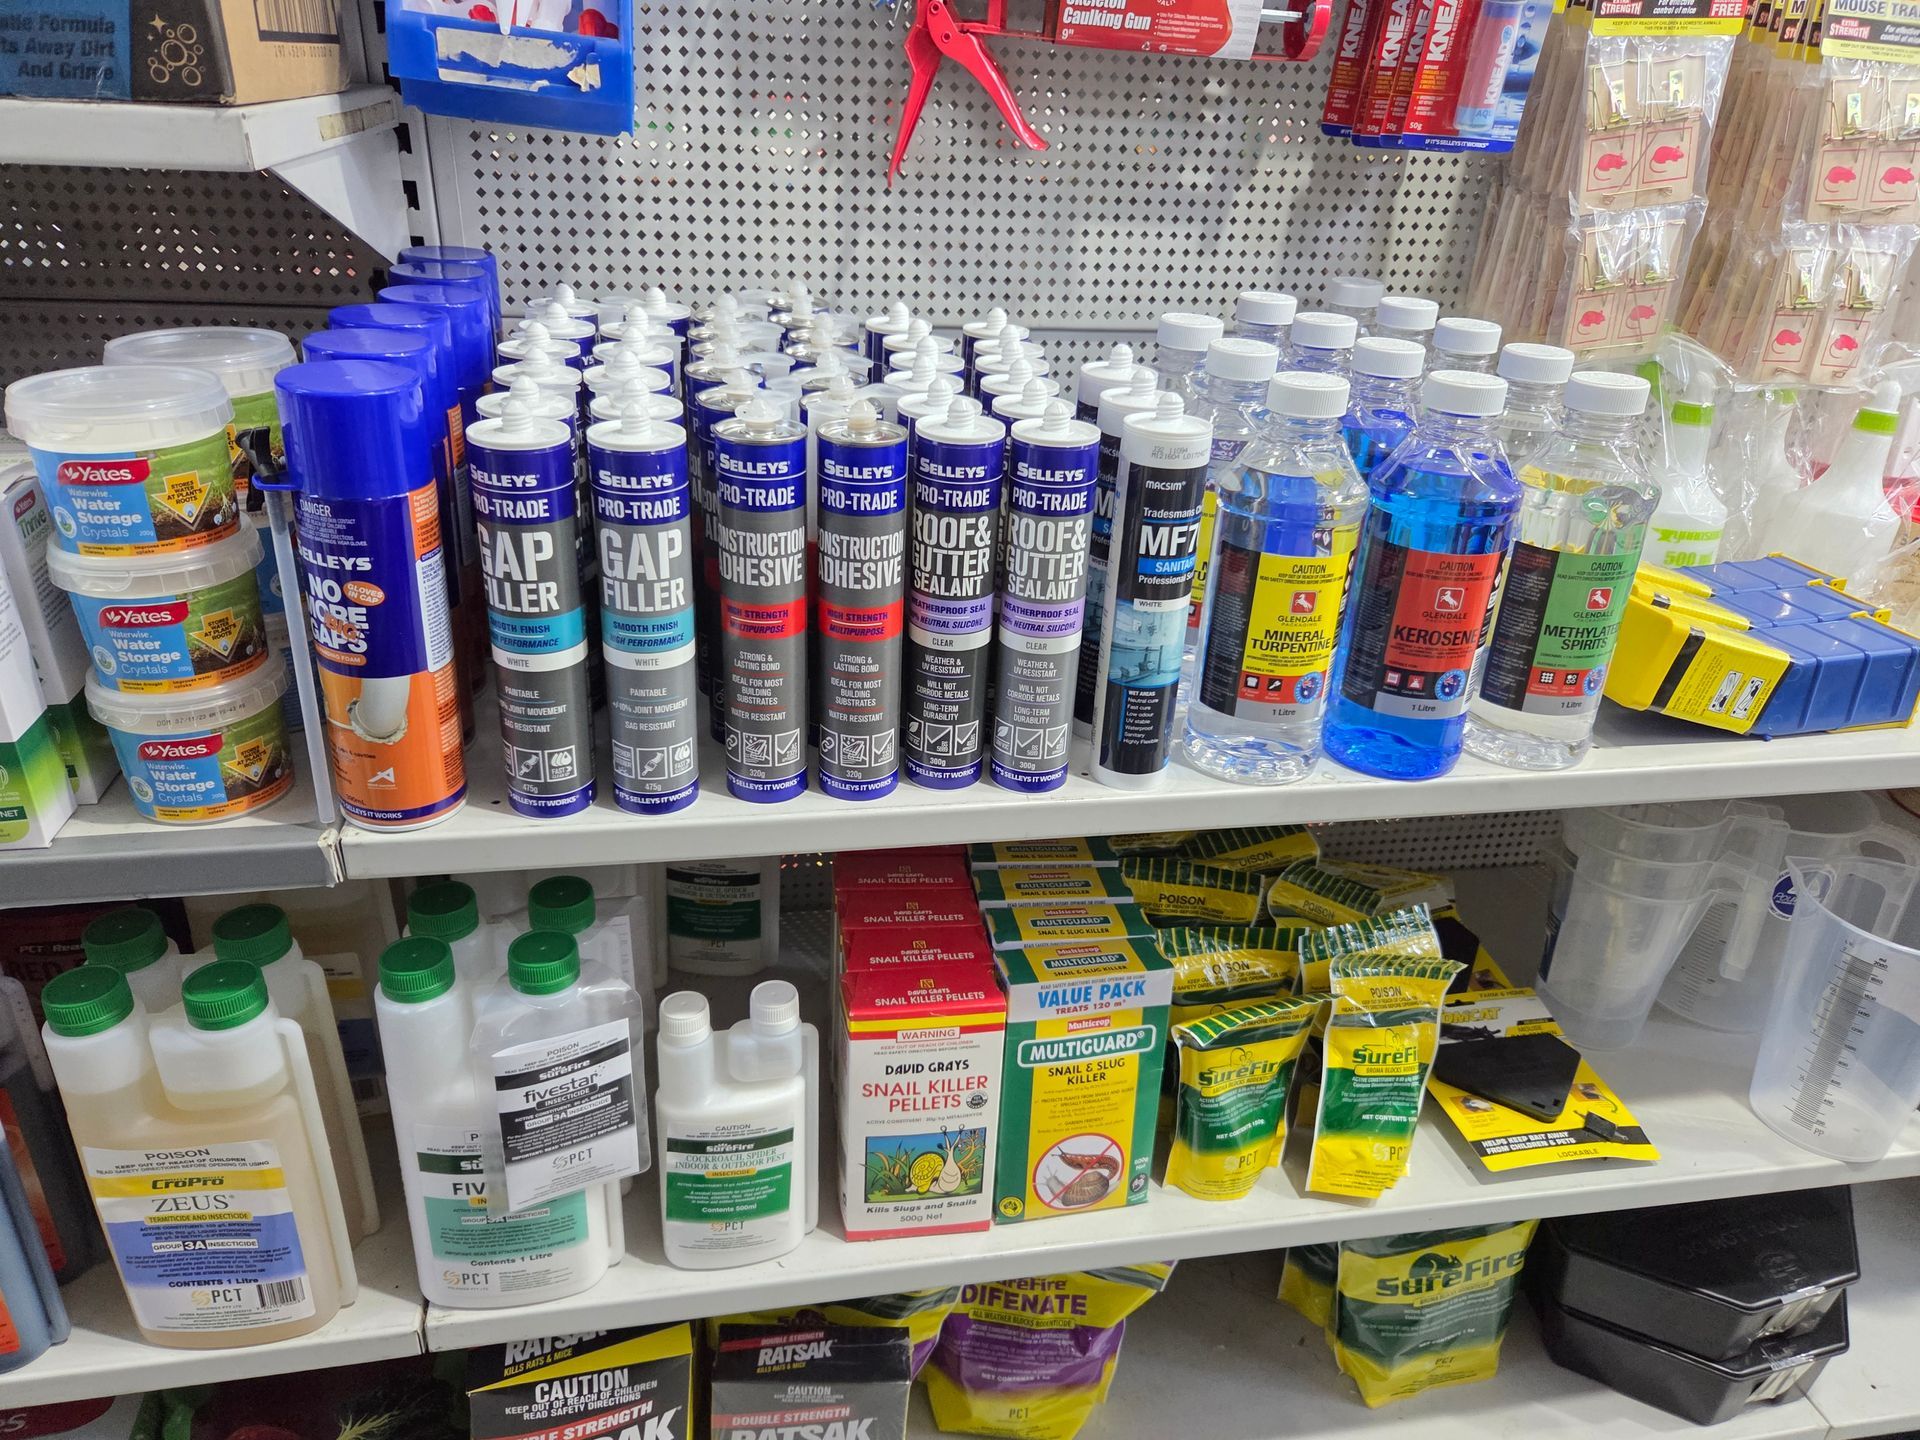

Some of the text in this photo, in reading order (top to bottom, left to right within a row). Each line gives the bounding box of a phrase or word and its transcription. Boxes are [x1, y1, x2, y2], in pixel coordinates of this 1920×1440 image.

[1601, 3, 1643, 15] STRENGTH
[1711, 4, 1741, 16] FREE
[1835, 0, 1886, 14] MOUSE
[38, 13, 115, 33] Formula
[1063, 7, 1123, 29] Caulking
[1124, 12, 1151, 30] Gun
[1062, 28, 1074, 40] 9"
[23, 39, 115, 60] Away Dirt
[17, 61, 53, 79] And
[1409, 122, 1422, 130] 50g
[719, 453, 788, 475] SELLEYS
[823, 459, 893, 479] SELLEYS
[919, 457, 986, 479] SELLEYS
[80, 466, 132, 484] Yates
[470, 463, 538, 488] SELLEYS
[1017, 462, 1084, 482] SELLEYS
[171, 480, 194, 489] STORES
[598, 469, 674, 489] SELLEYS
[1146, 480, 1182, 491] MACSIM
[177, 488, 202, 498] PLANT'S
[718, 480, 796, 507] PRO-TRADE
[821, 486, 897, 511] PRO-TRADE
[915, 481, 990, 507] PRO-TRADE
[1012, 485, 1088, 511] PRO-TRADE
[72, 498, 122, 511] Water
[176, 496, 198, 504] ROOTS
[300, 499, 332, 517] DANGER
[598, 496, 681, 520] PRO-TRADE
[1143, 505, 1195, 518] Tradesmans
[20, 508, 48, 537] Thrive
[78, 512, 142, 526] Storage
[82, 526, 129, 538] Crystals
[913, 507, 991, 549] ROOF&
[1009, 512, 1087, 552] ROOF&
[477, 521, 554, 582] GAP
[600, 527, 683, 581] GAP
[912, 539, 990, 576] GUTTER
[1006, 543, 1084, 580] GUTTER
[1439, 561, 1475, 571] CAUTION
[1591, 562, 1623, 571] CAUTION
[1292, 564, 1327, 574] CAUTION
[308, 573, 341, 603] NO
[913, 569, 984, 597] SEALANT
[1007, 573, 1078, 600] SEALANT
[347, 584, 383, 598] GLOVES
[348, 591, 357, 599] IN
[482, 575, 560, 613] FILLER
[602, 576, 686, 613] FILLER
[1139, 600, 1162, 608] WHITE
[120, 608, 172, 624] Yates
[845, 612, 888, 620] STRENGTH
[1421, 611, 1468, 619] GLENDALE
[521, 622, 550, 633] FINISH
[613, 621, 679, 633] SMOOTH FINISH
[627, 633, 685, 647] PERFORMANCE
[1264, 629, 1325, 642] MINERAL
[1393, 625, 1478, 646] KEROSENE
[112, 639, 160, 651] Water
[1025, 642, 1047, 651] CLEAR
[1251, 637, 1332, 653] TURPENTINE
[1560, 638, 1608, 651] SPIRITS
[118, 650, 180, 663] Storage
[339, 654, 361, 663] FOAM
[634, 658, 660, 667] WHITE
[839, 654, 866, 664] STRONG
[121, 662, 168, 676] Crystals
[833, 661, 879, 673] LASTING BOND
[1017, 658, 1048, 669] WEATHER
[1027, 667, 1057, 678] RESISTANT
[629, 687, 668, 697] PAINTABLE
[840, 688, 871, 698] BUILDING
[633, 698, 689, 714] JOINT MOVEMENT
[835, 696, 876, 707] SUBSTRATES
[1014, 705, 1050, 716] LONG-TERM
[1278, 708, 1296, 716] Litre
[624, 720, 677, 731] SAG RESISTANT
[1013, 713, 1051, 725] DURABILITY
[158, 742, 208, 758] Yates
[930, 757, 946, 767] 300g
[150, 770, 196, 782] Water
[845, 769, 862, 779] 320g
[155, 780, 215, 792] Storage
[645, 782, 661, 792] 475g
[158, 792, 203, 804] Crystals
[374, 810, 402, 818] WORKS
[1158, 893, 1207, 906] POISON
[1036, 918, 1101, 926] MULTIGUARD
[1038, 980, 1147, 1009] VALUE PACK
[1370, 986, 1402, 998] POISON
[901, 1029, 956, 1040] WARNING
[546, 1042, 580, 1057] POISON
[1030, 1032, 1138, 1061] MULTIGUARD
[885, 1059, 970, 1075] DAVID GRAYS
[1048, 1058, 1125, 1077] SNAIL SLUG
[1067, 1073, 1106, 1086] KILLER
[523, 1071, 599, 1103] fivestar
[862, 1075, 988, 1098] SNAIL KILLER
[545, 1088, 590, 1106] INSECTICIDE
[889, 1094, 962, 1113] PELLETS
[715, 1124, 751, 1132] CAUTION
[144, 1149, 211, 1161] POISON
[568, 1148, 593, 1164] PCT
[746, 1148, 777, 1160] SPIDER
[1557, 1148, 1600, 1159] LOCKABLE
[675, 1158, 764, 1170] INDOOR OUTDOOR
[151, 1194, 230, 1213] ZEUS
[893, 1199, 977, 1213] Slugs Snails
[148, 1212, 249, 1223] TERMITICIDE INSECTICIDE
[470, 1251, 553, 1267] Contents Litre
[1376, 1250, 1526, 1298] SureFire
[168, 1278, 224, 1288] CONTENTS
[211, 1288, 243, 1303] PCT
[961, 1285, 1088, 1317] DIFENATE
[757, 1340, 834, 1367] RATSAK
[534, 1368, 629, 1404] CAUTION
[787, 1386, 831, 1396] CAUTION
[505, 1402, 550, 1416] KEEP OUT
[550, 1404, 587, 1417] SAFETY
[563, 1401, 654, 1440] STRENGTH
